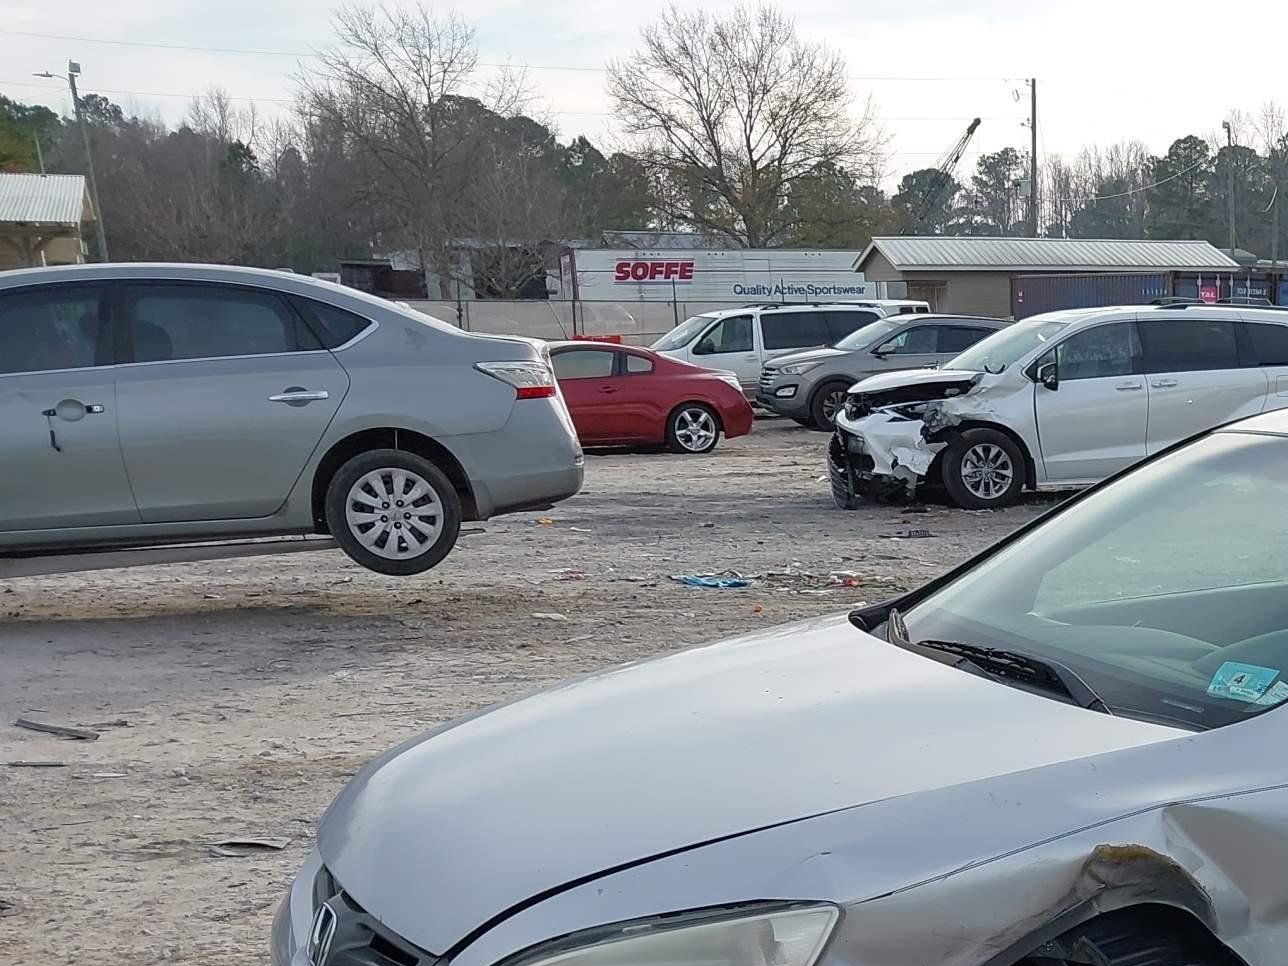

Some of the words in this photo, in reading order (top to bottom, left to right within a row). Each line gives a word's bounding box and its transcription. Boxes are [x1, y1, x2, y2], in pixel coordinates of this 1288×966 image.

[614, 262, 694, 280] SOFFE
[733, 284, 772, 296] Quality
[774, 285, 805, 294] Active
[806, 284, 865, 296] Sportswear
[1234, 674, 1246, 684] 4
